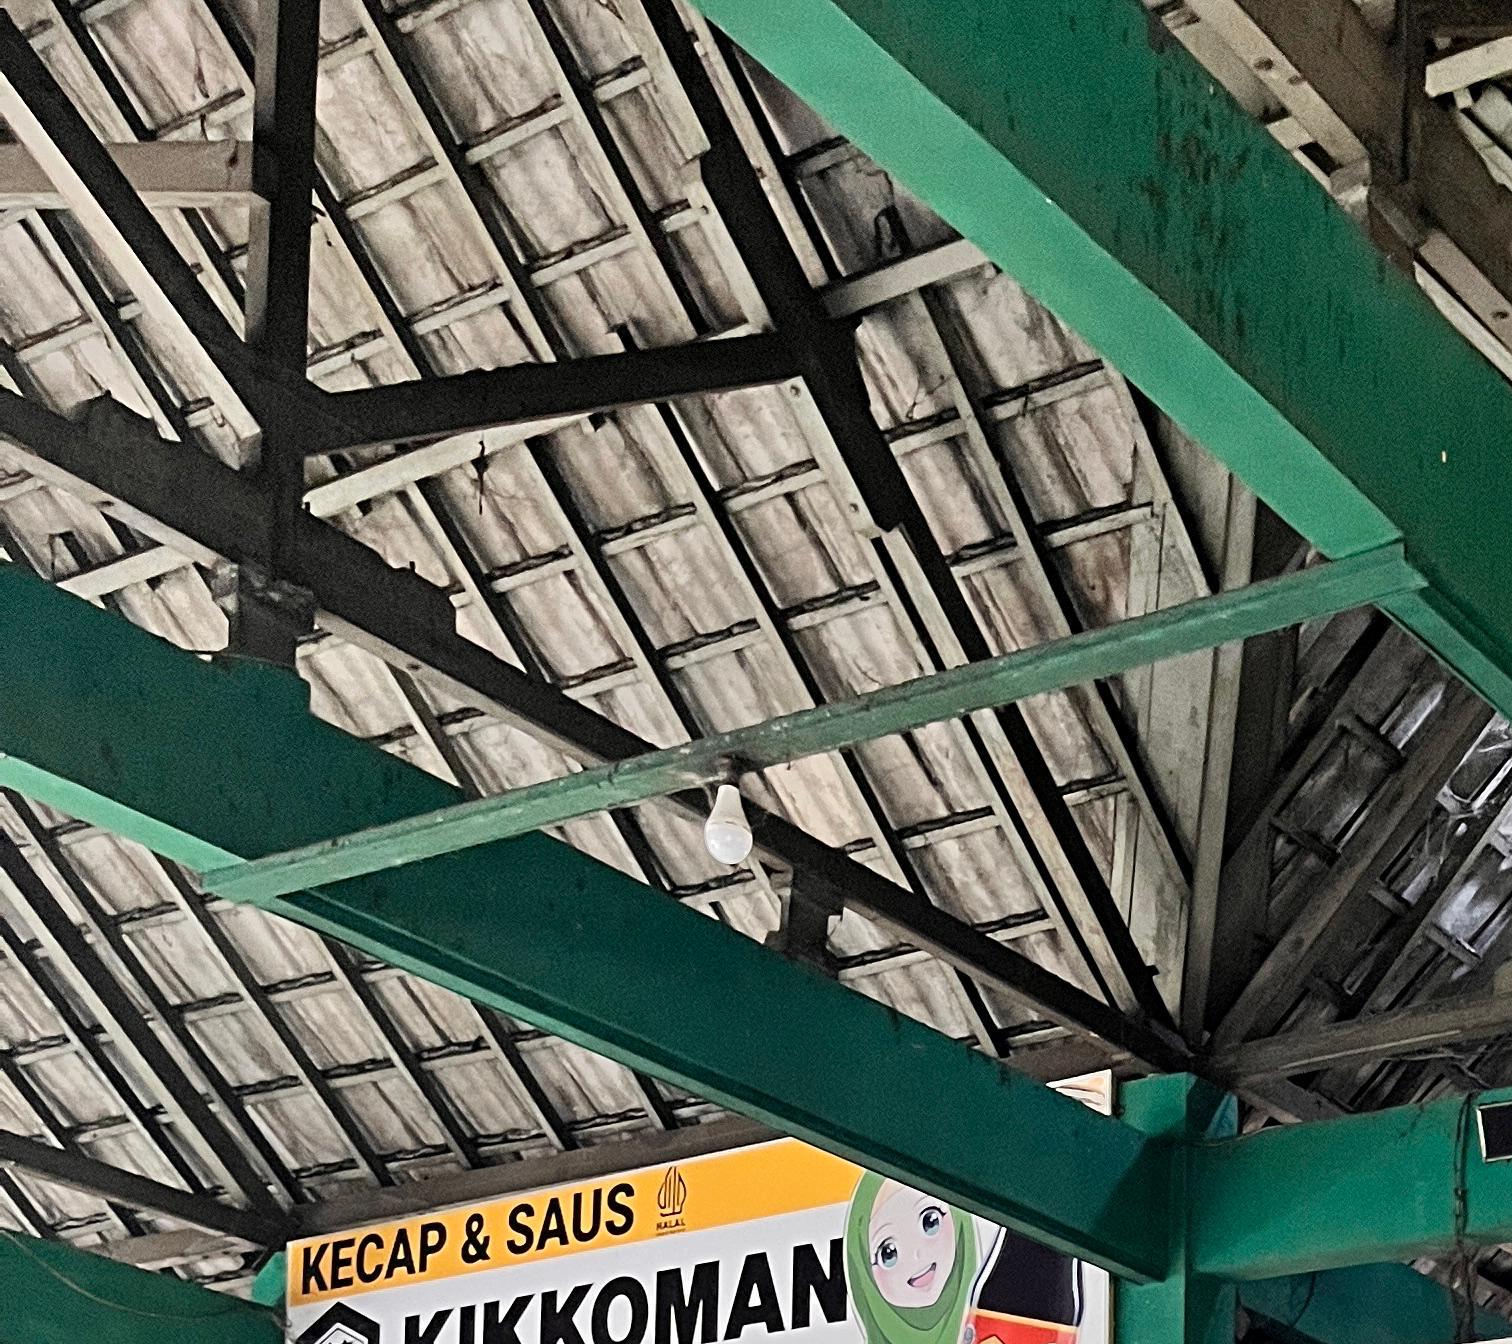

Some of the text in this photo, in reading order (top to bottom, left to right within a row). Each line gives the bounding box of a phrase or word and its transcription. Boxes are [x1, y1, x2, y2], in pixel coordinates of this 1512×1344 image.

[301, 1182, 634, 1295] KECAP & SAUS
